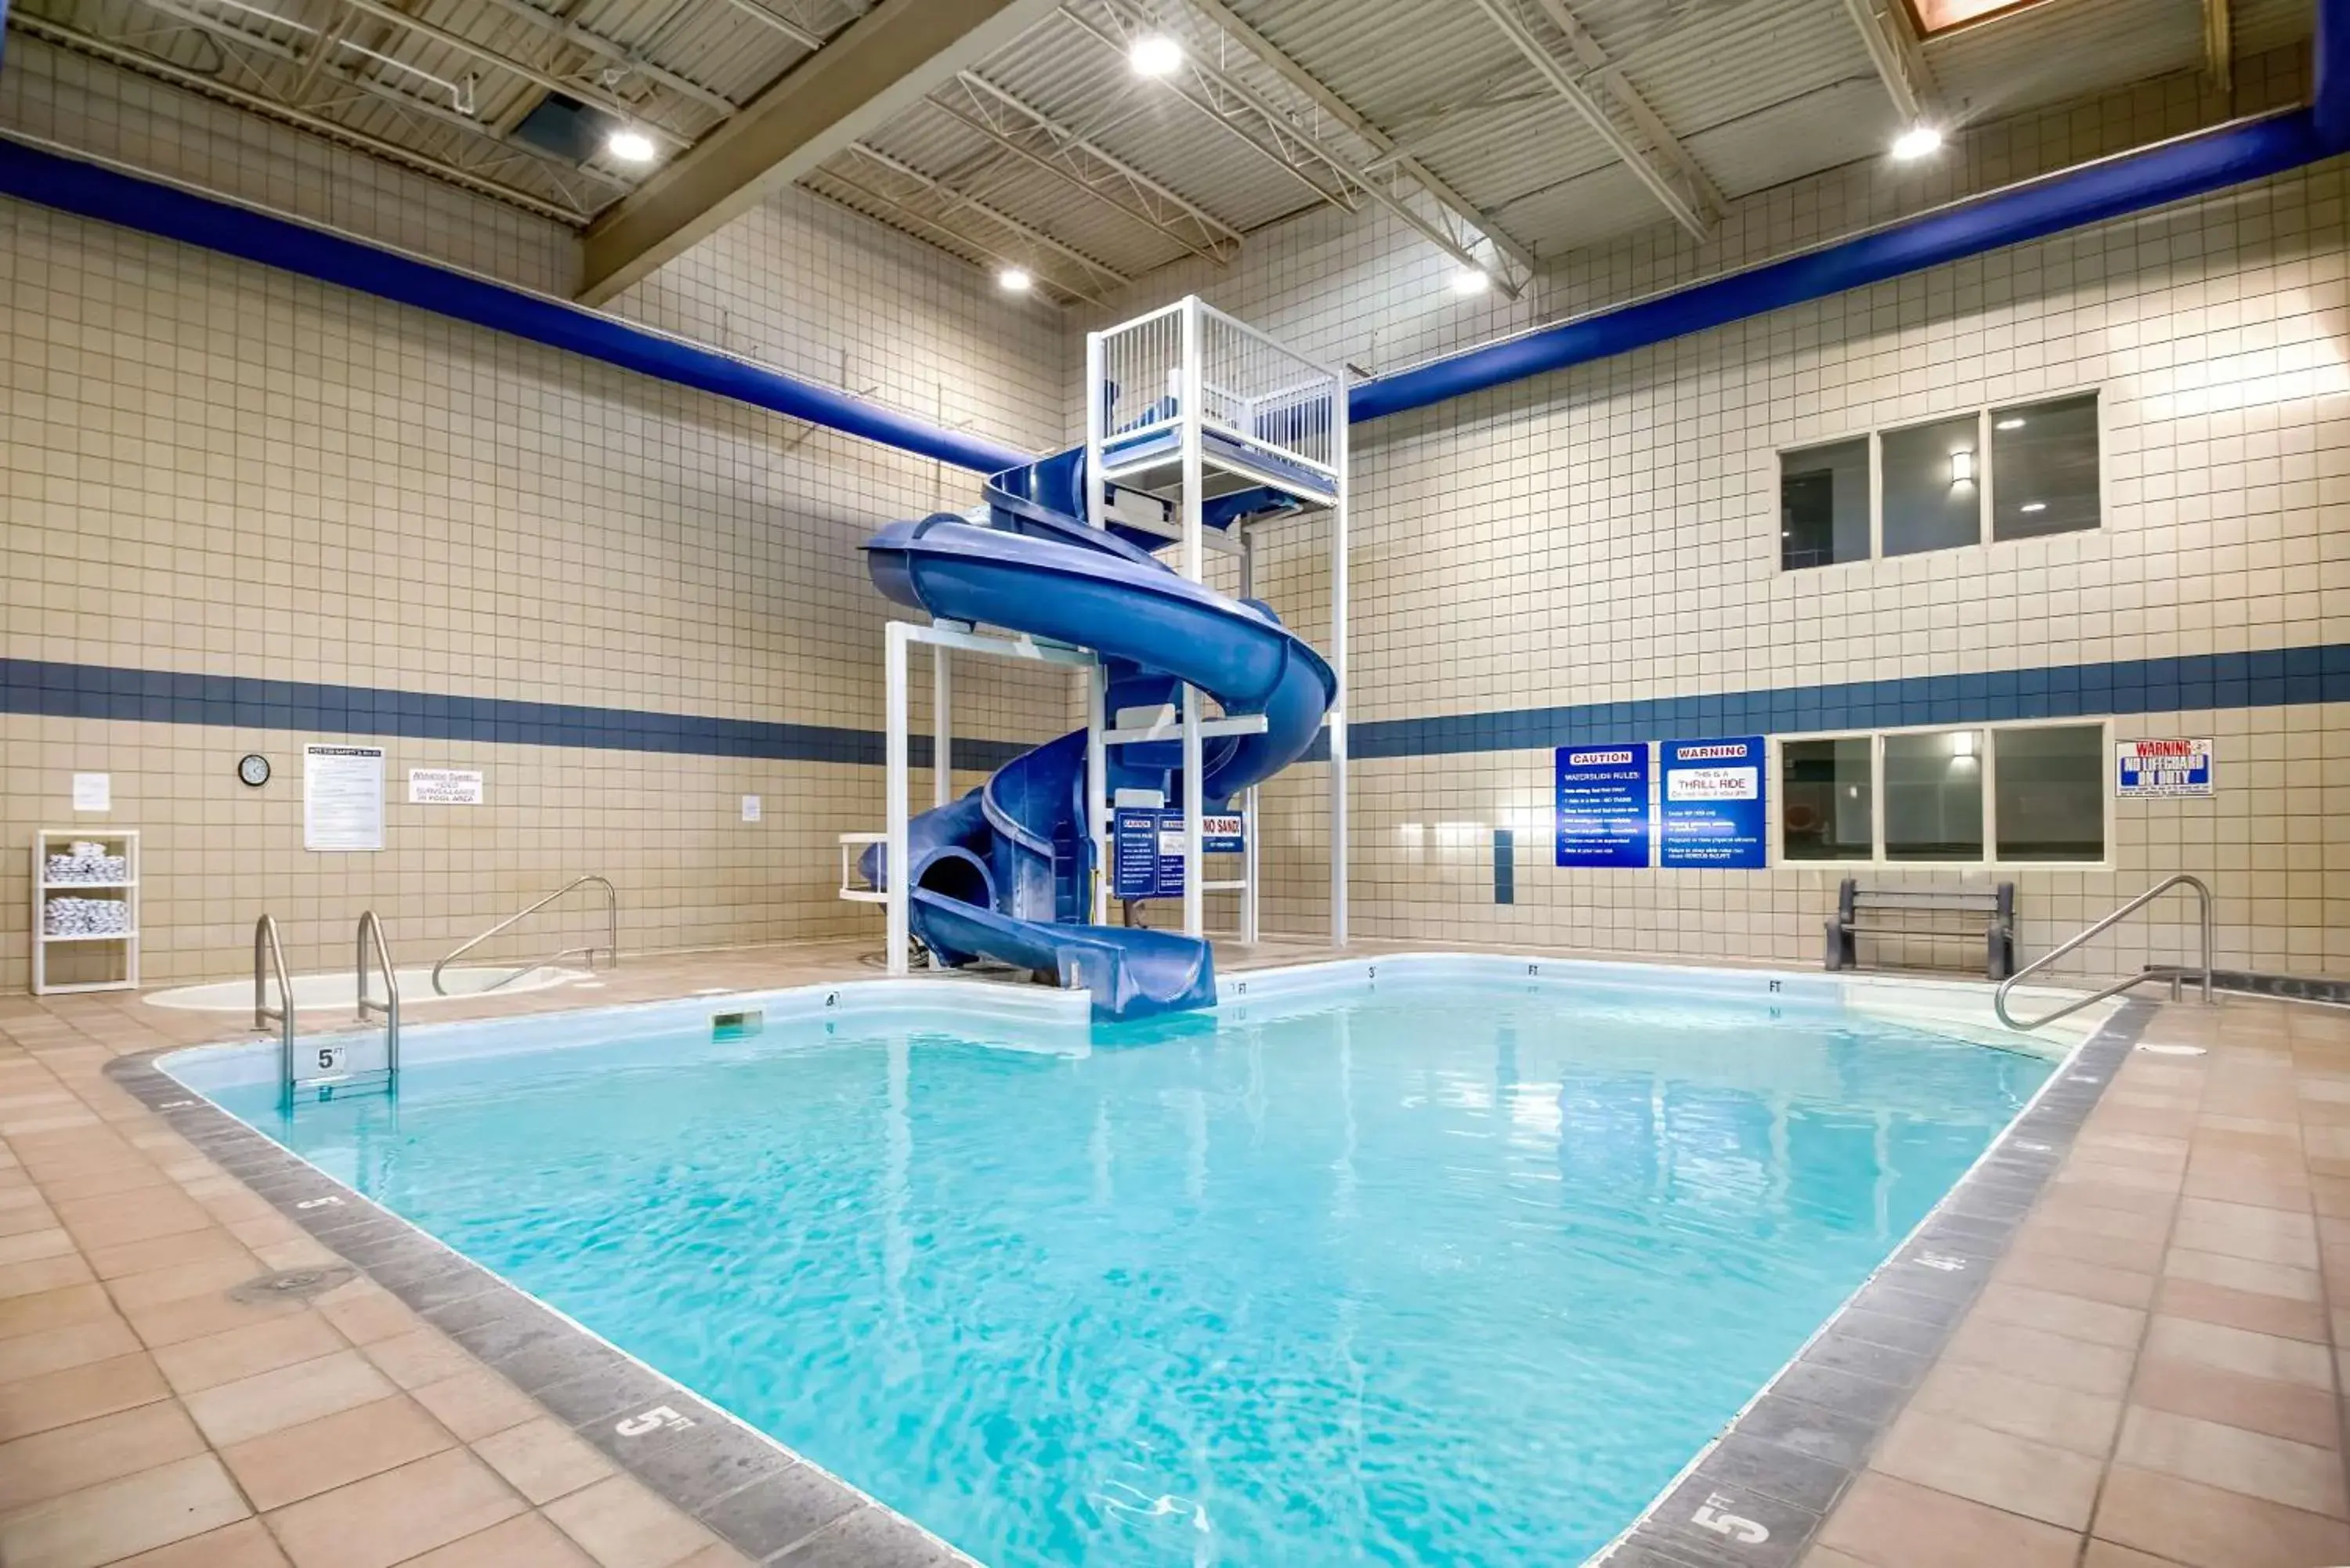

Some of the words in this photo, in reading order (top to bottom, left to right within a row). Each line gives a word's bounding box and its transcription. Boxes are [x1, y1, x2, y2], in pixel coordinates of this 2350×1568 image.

[1679, 746, 1745, 758] WARNING
[2136, 741, 2191, 757] WARNING
[1574, 753, 1629, 764] CAUTION
[2124, 757, 2141, 771] NO
[2142, 754, 2204, 771] LIFEGUARD
[1678, 779, 1716, 789] THRILL
[1719, 778, 1746, 789] RIDE
[2138, 771, 2155, 786] ON
[2158, 769, 2191, 785] DUTY
[1203, 818, 1215, 833] NO
[1770, 980, 1781, 992] FT
